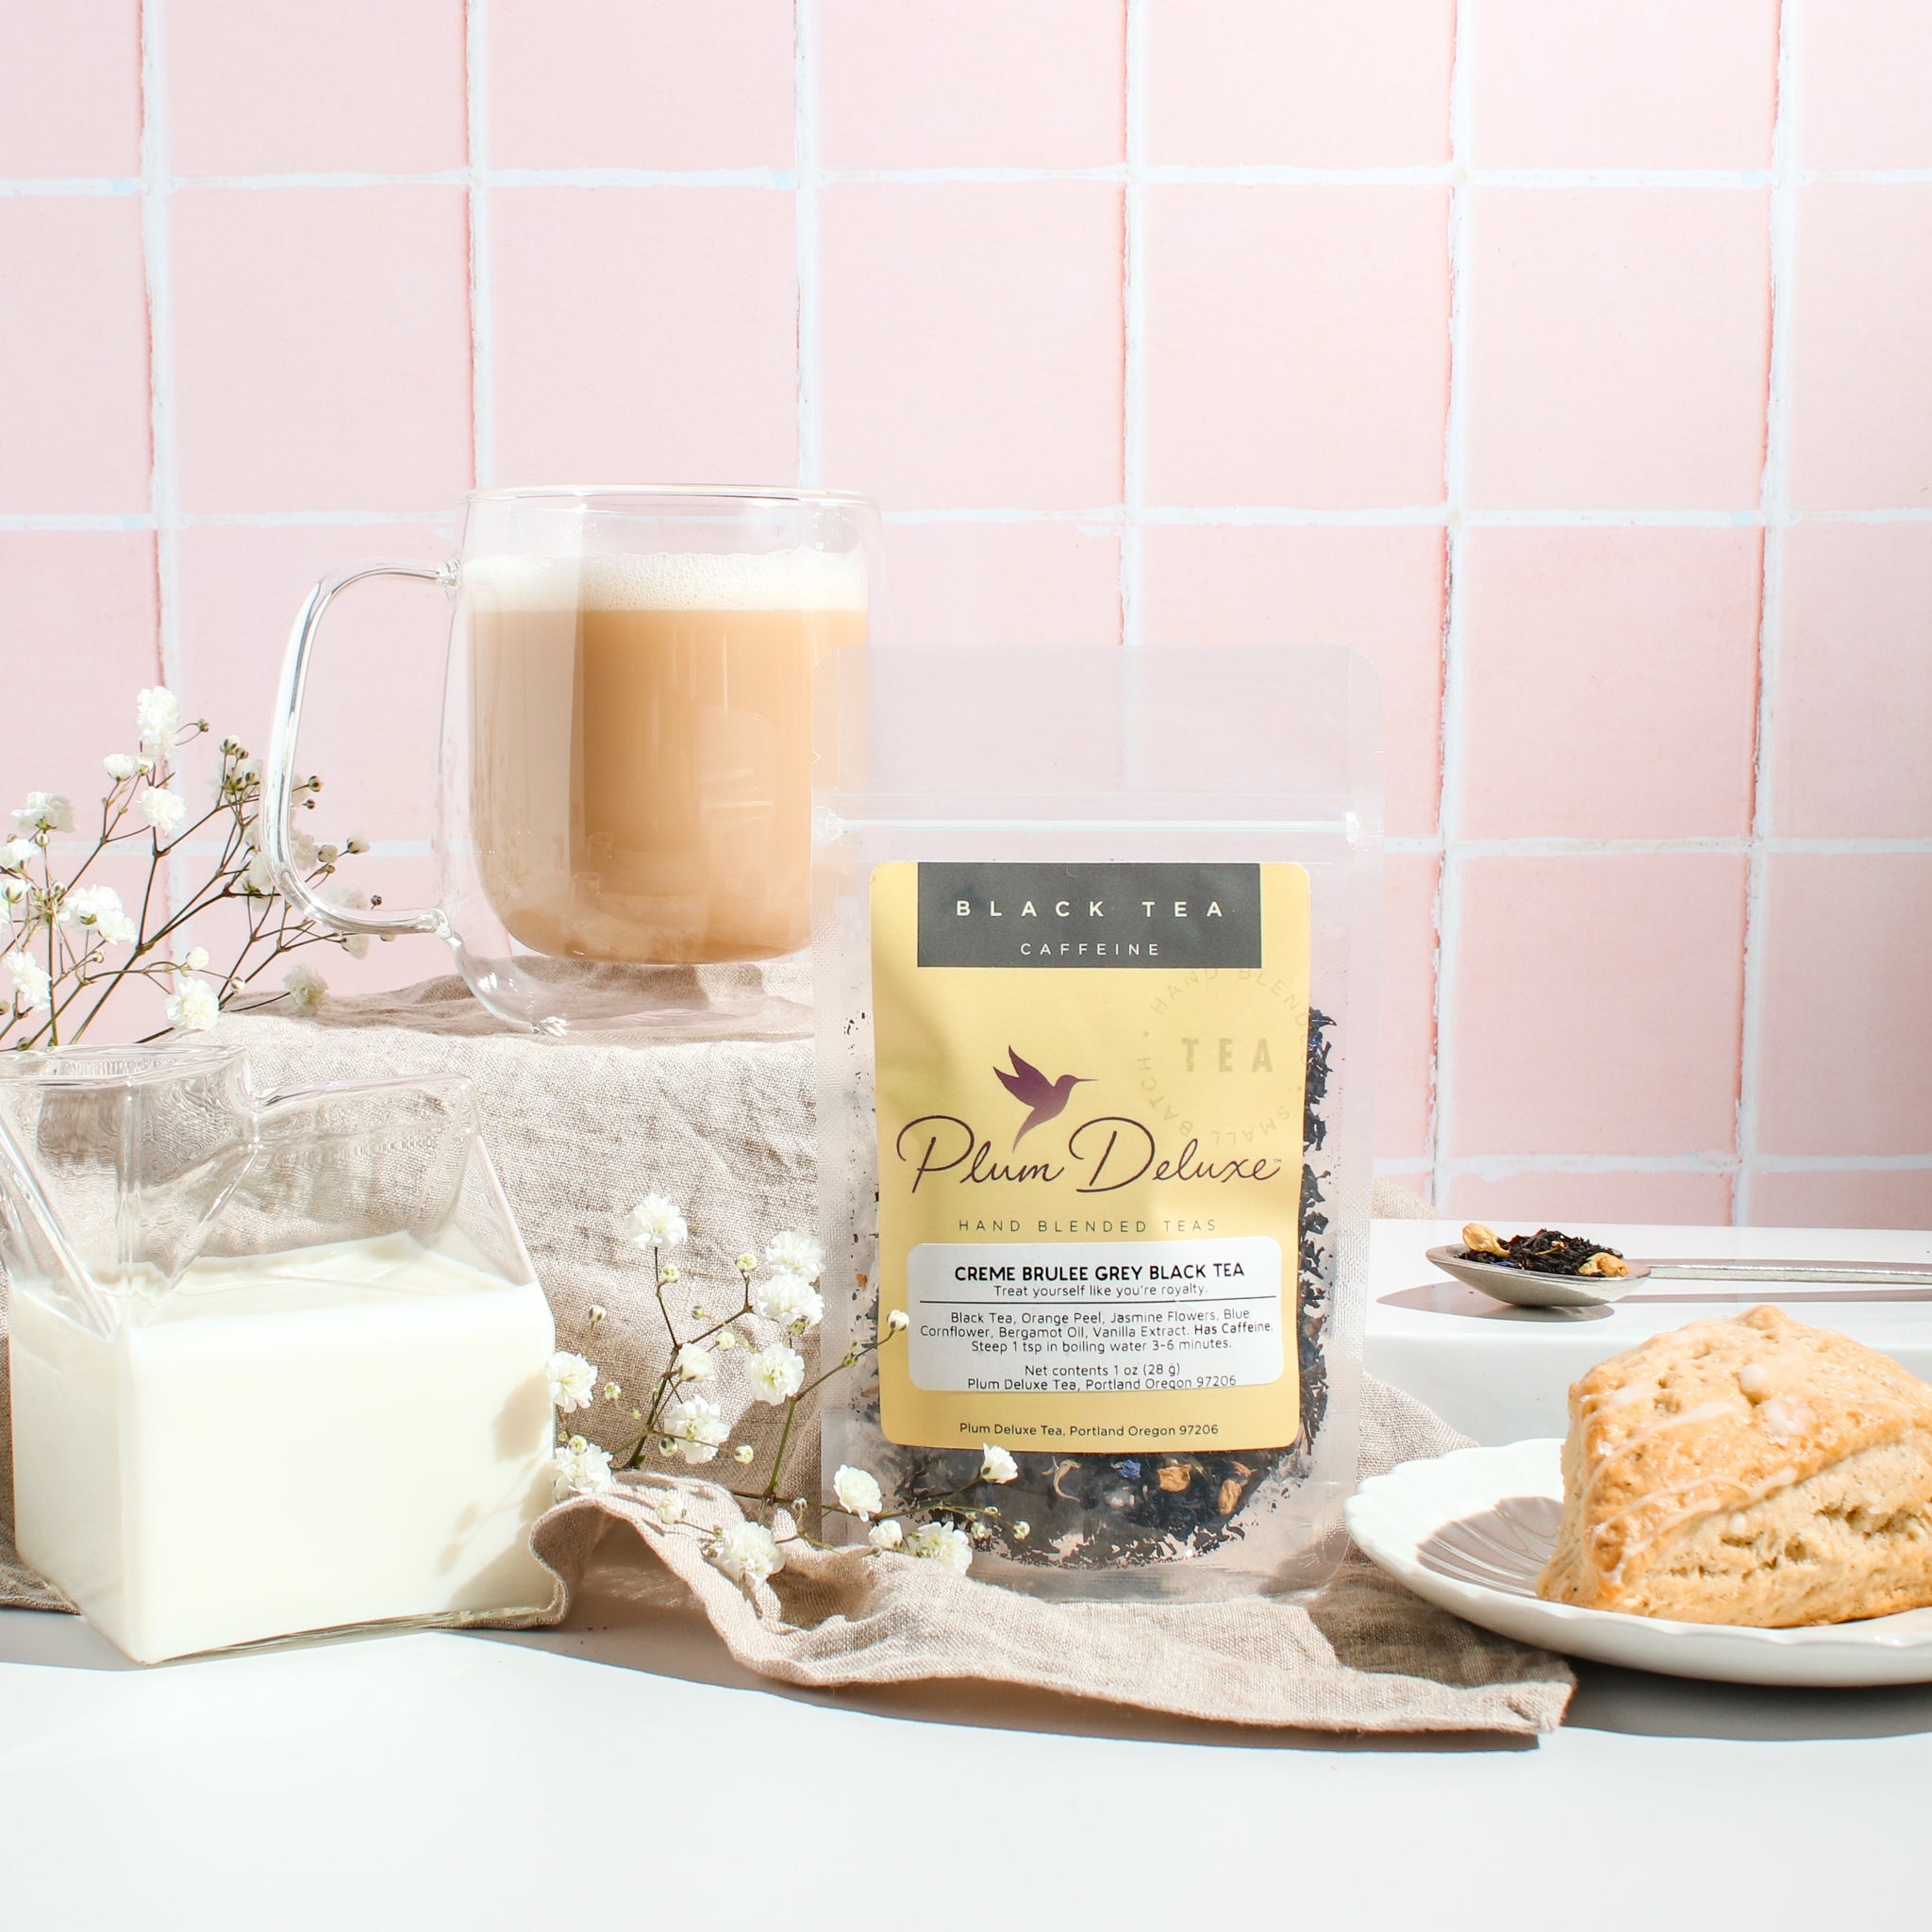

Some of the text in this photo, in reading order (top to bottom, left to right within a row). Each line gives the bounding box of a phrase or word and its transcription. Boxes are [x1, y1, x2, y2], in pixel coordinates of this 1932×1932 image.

[957, 900, 1223, 918] BLACK TEA
[1020, 942, 1158, 956] CAFFEINE
[1150, 969, 1219, 1014] HAND
[1181, 1036, 1274, 1073] TEA
[1136, 1057, 1194, 1137] BATCH
[1210, 1105, 1291, 1147] SMALL
[896, 1115, 1064, 1193] Plum
[1068, 1116, 1281, 1193] Deluxe
[958, 1219, 1216, 1233] HAND BLENDED TEAS
[955, 1262, 1244, 1281] CREME BRULEE GREY BLACK TEA
[993, 1283, 1208, 1298] Treat yourself like you're royalty.
[952, 1308, 1249, 1326] Black Tea, Orange Peel, Jasmine Flowers, Blue
[921, 1322, 1273, 1341] Cornflower, Bergamot Oil, Vanilla Extract. Has Caffeine.
[972, 1339, 1231, 1355] Steep 1 tsp in boiling water 3-6 minutes.
[1025, 1363, 1179, 1376] Net contents 1 oz (28 g)
[968, 1375, 1236, 1391] Plum Deluxe Tea, Portland Oregon 97206
[959, 1422, 1219, 1438] Plum Deluxe Tea, Portland Oregon 97206
